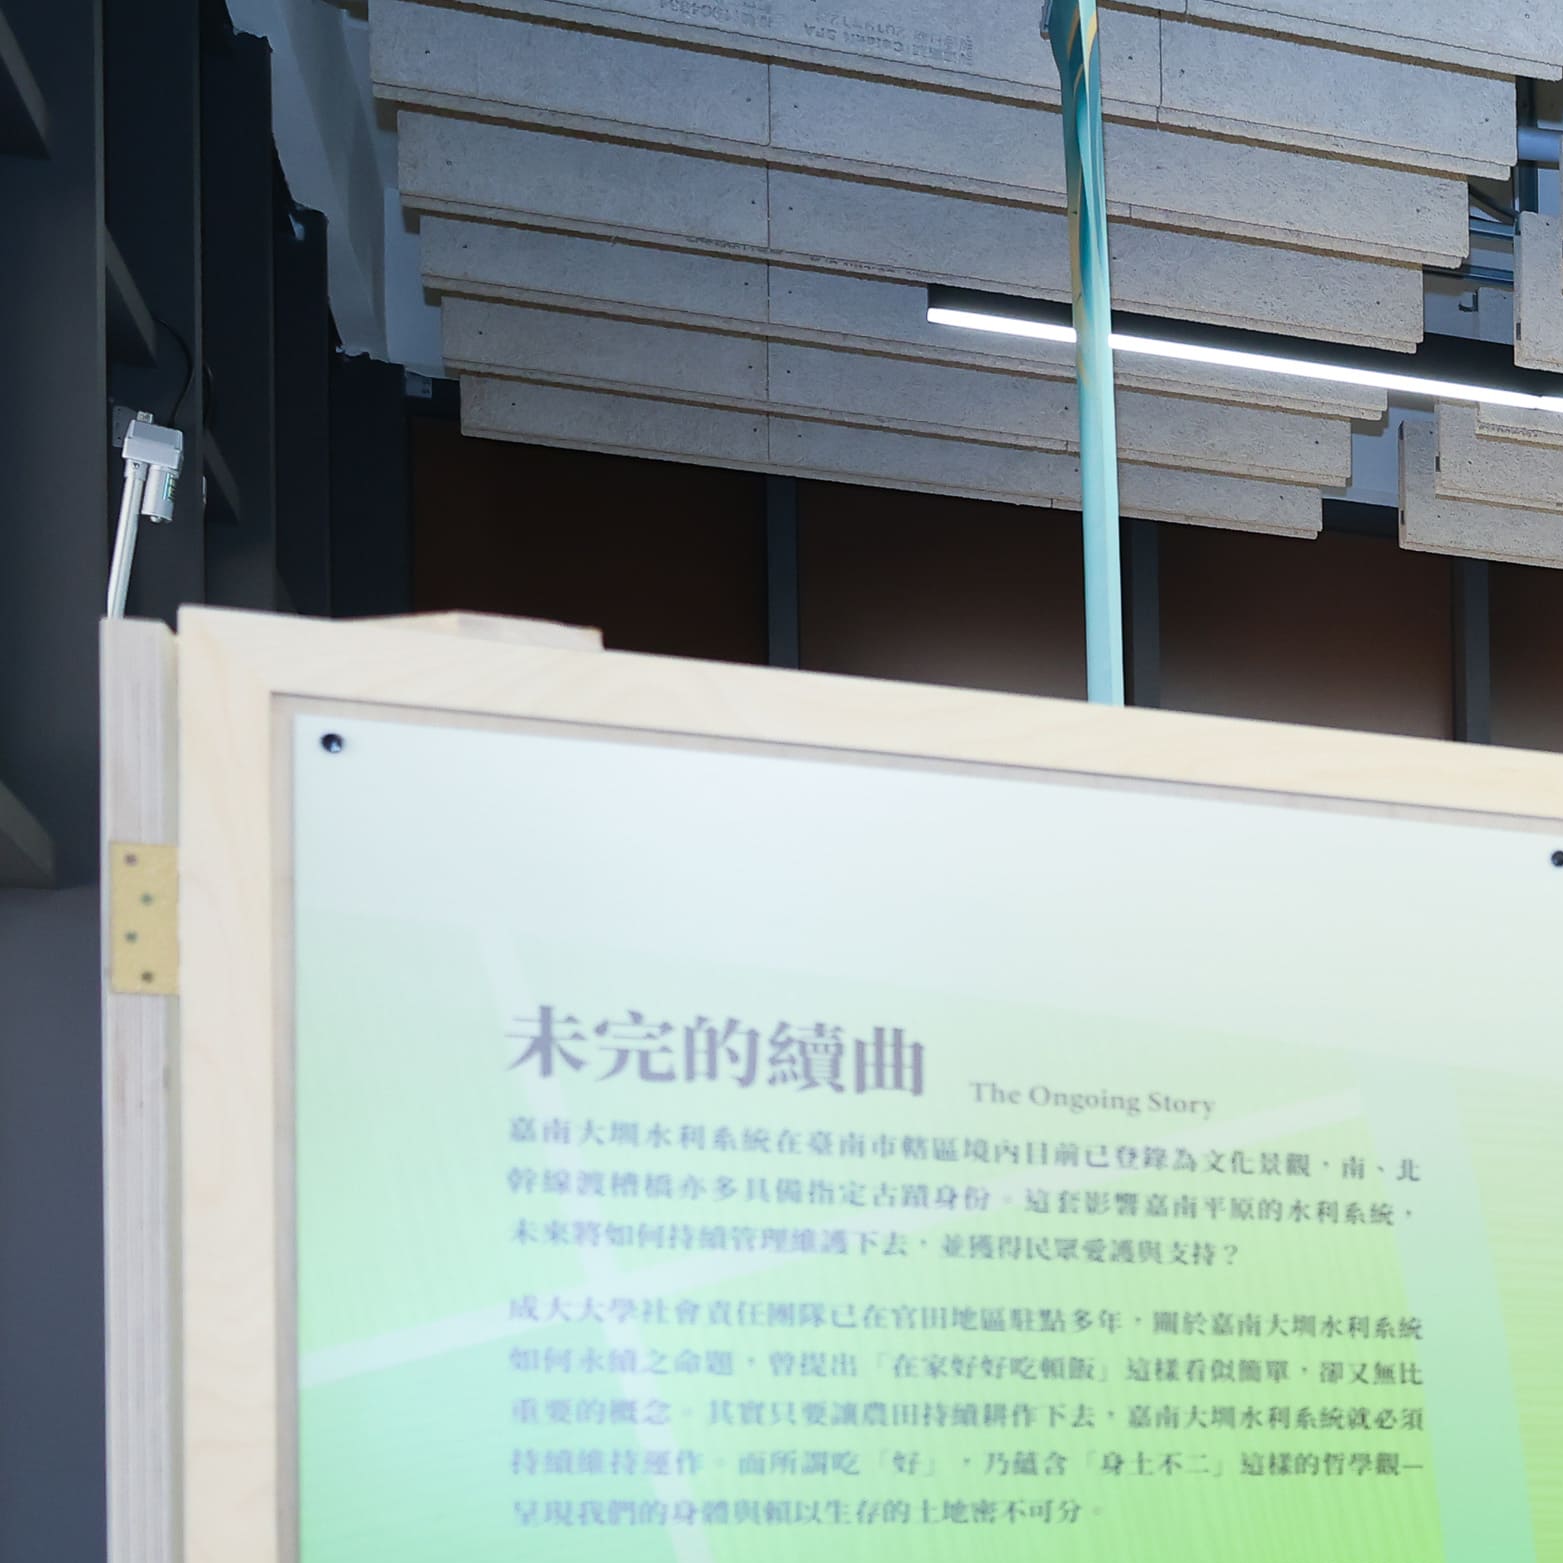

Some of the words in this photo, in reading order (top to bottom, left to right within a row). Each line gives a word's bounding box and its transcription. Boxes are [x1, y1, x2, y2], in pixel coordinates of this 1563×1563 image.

[503, 1003, 926, 1098] 未完的續曲
[968, 1080, 1022, 1104] The
[1029, 1084, 1142, 1116] Ongoing
[1146, 1089, 1216, 1120] Story
